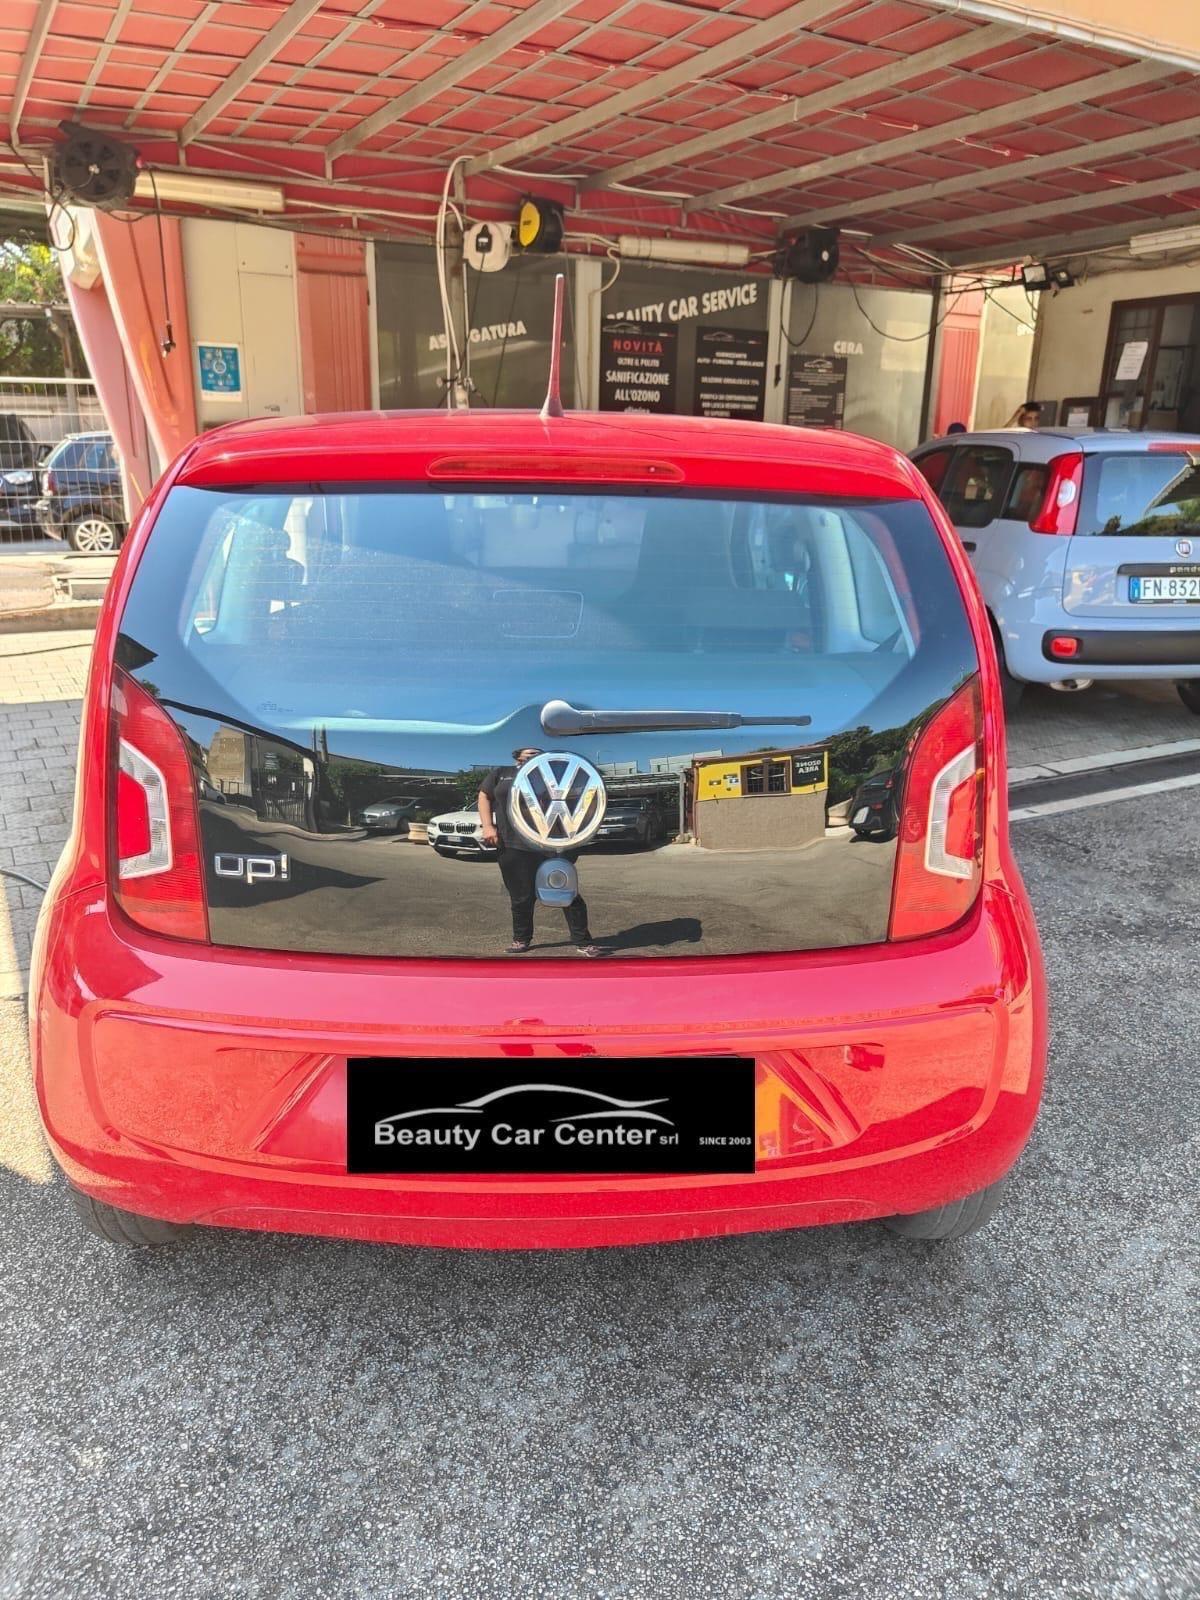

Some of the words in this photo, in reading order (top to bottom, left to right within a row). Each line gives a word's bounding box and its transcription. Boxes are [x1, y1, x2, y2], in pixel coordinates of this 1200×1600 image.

[668, 296, 698, 321] CAR
[702, 283, 758, 314] SERVICE
[613, 339, 663, 353] NOVITÀ
[834, 340, 864, 354] CERA
[606, 370, 669, 385] SANIFICAZIONE
[614, 388, 660, 402] ALL'OZONO
[1143, 579, 1162, 597] FN
[1168, 579, 1200, 597] 832
[214, 853, 289, 884] up!
